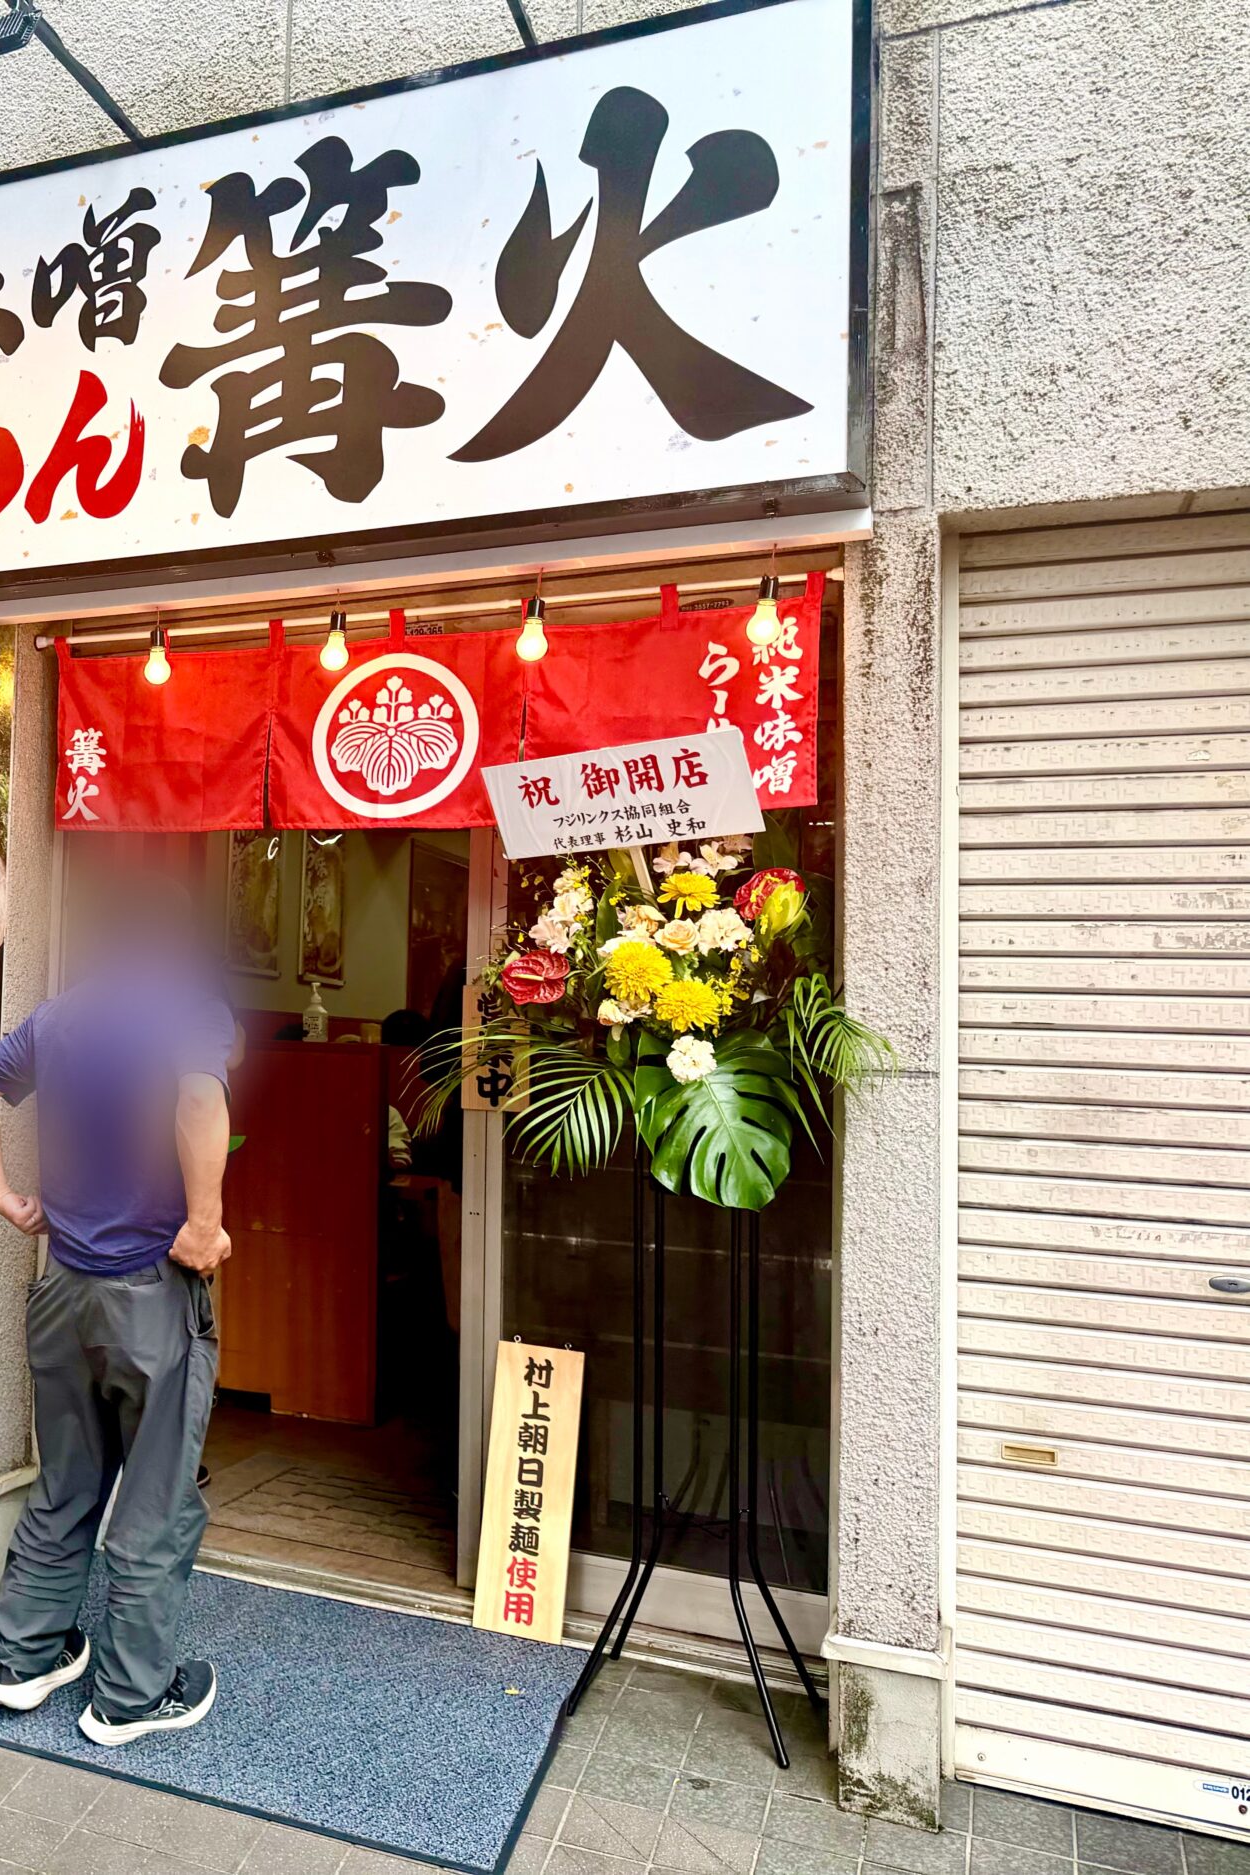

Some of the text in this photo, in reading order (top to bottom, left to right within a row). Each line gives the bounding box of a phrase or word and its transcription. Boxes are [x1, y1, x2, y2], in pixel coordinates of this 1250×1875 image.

[158, 86, 814, 519] 篝火
[62, 727, 107, 821] 篝火
[518, 748, 709, 809] 祝 御開店
[553, 798, 692, 829] フジリンクス協同組合
[553, 832, 607, 850] 代表理事
